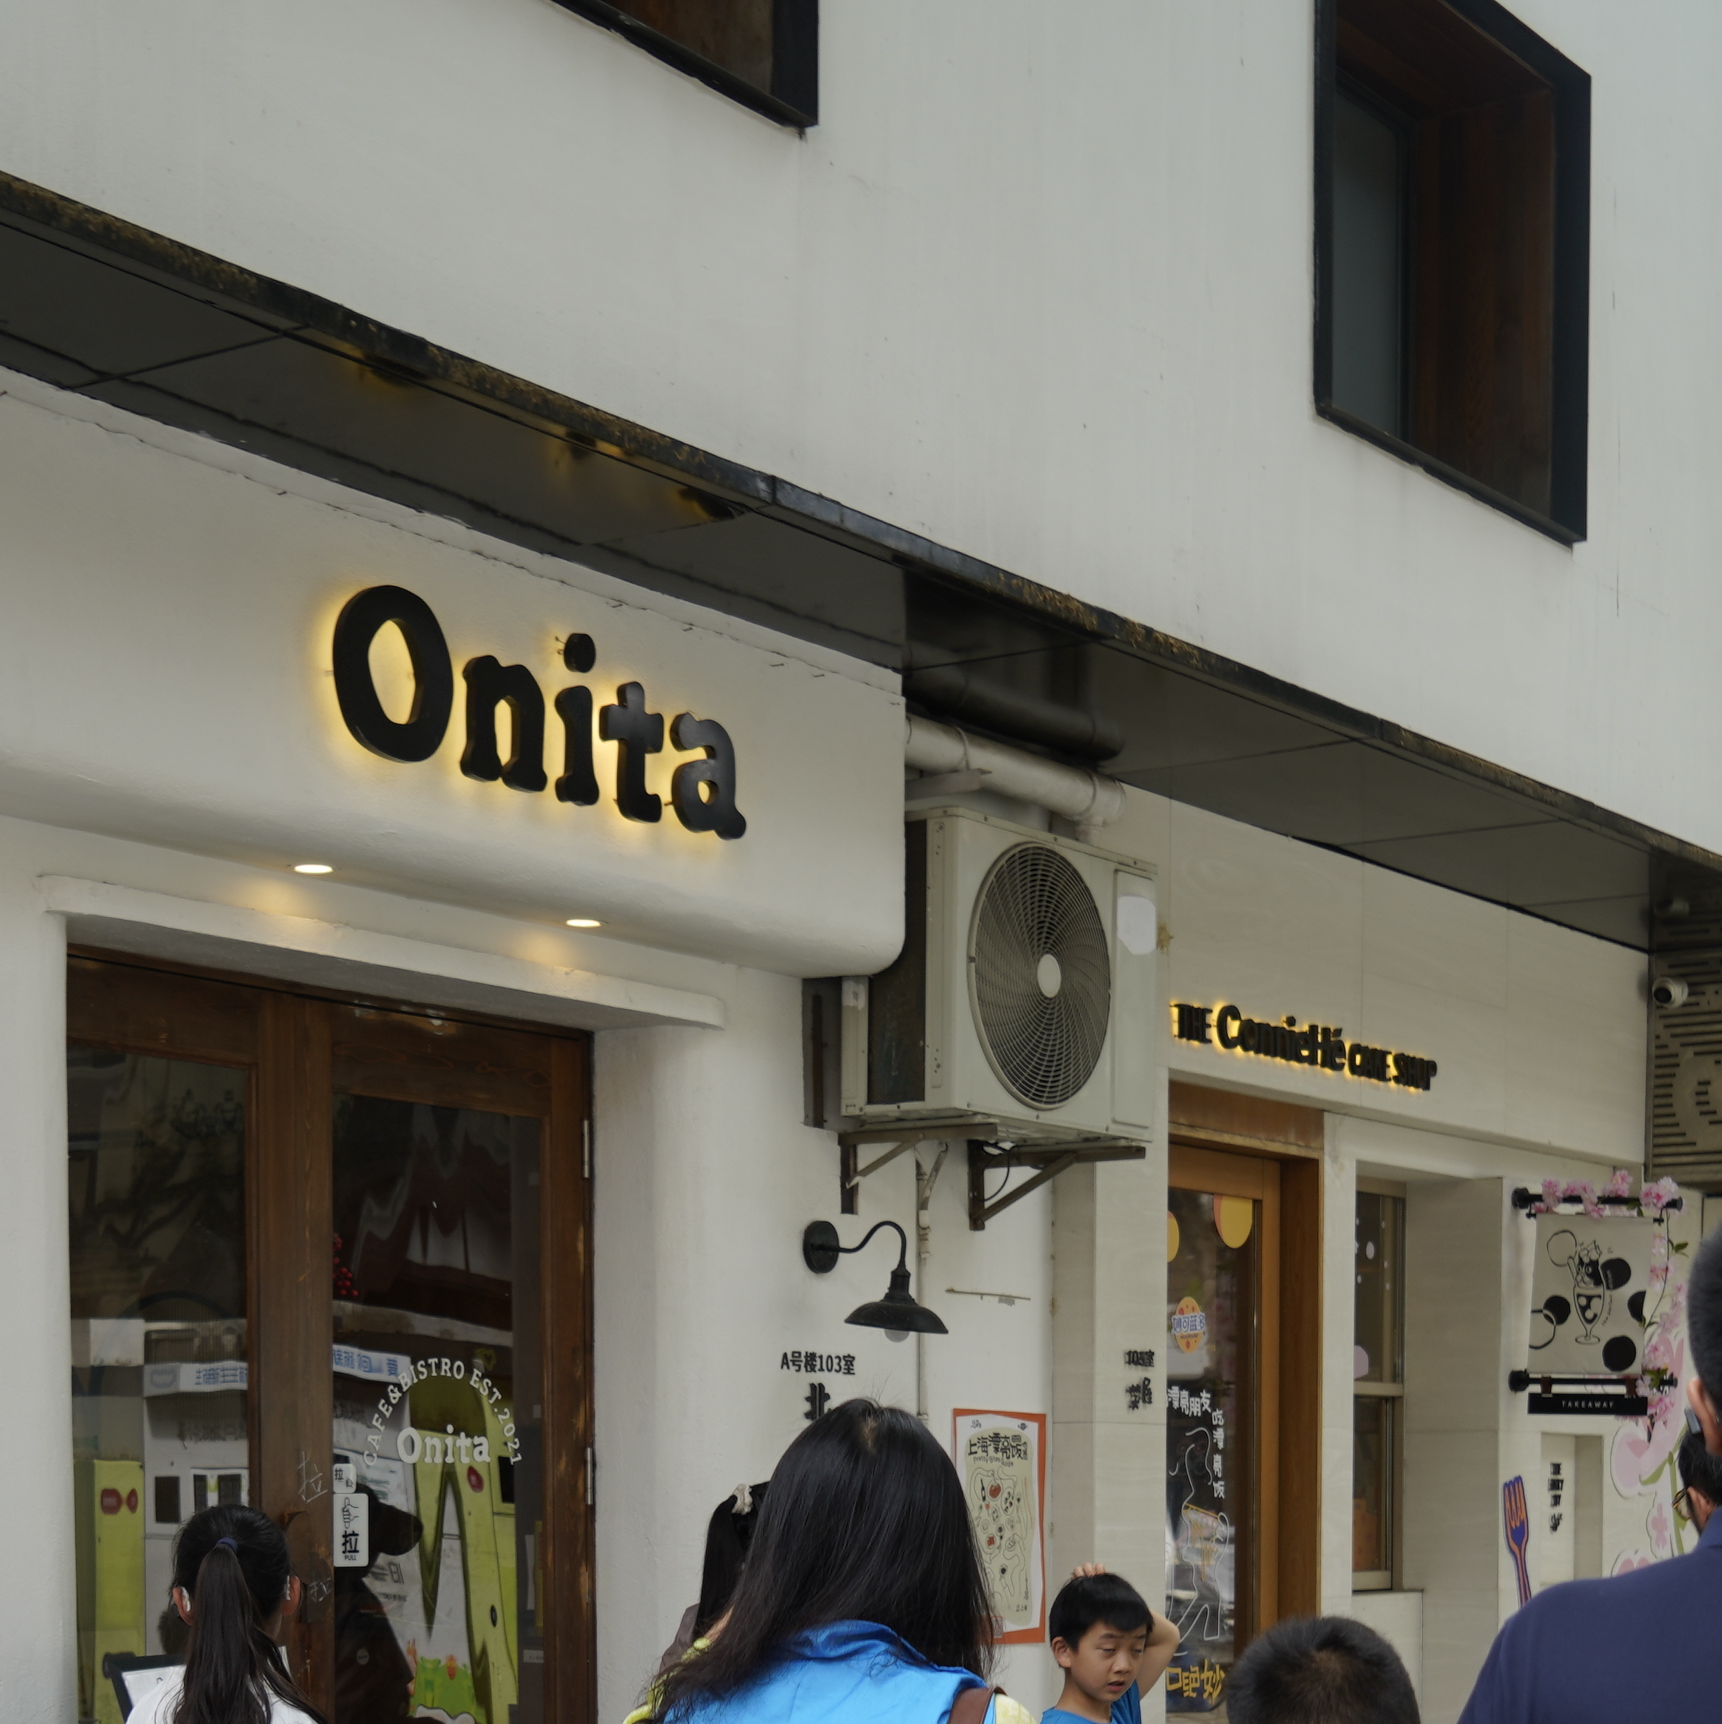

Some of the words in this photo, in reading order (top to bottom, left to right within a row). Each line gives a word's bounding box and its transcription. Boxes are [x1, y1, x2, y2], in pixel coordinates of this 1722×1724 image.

[332, 584, 747, 840] Onita
[780, 1350, 856, 1375] A号楼103室
[362, 1355, 466, 1468] CAFE&BISTRO
[470, 1369, 522, 1466] EST.2021
[1166, 1385, 1212, 1418] 漂亮朋友
[1561, 1399, 1615, 1409] TAKEAWAY
[396, 1424, 492, 1466] Onita
[297, 1451, 328, 1504] 拉
[341, 1530, 360, 1554] 拉
[343, 1554, 357, 1562] PULL
